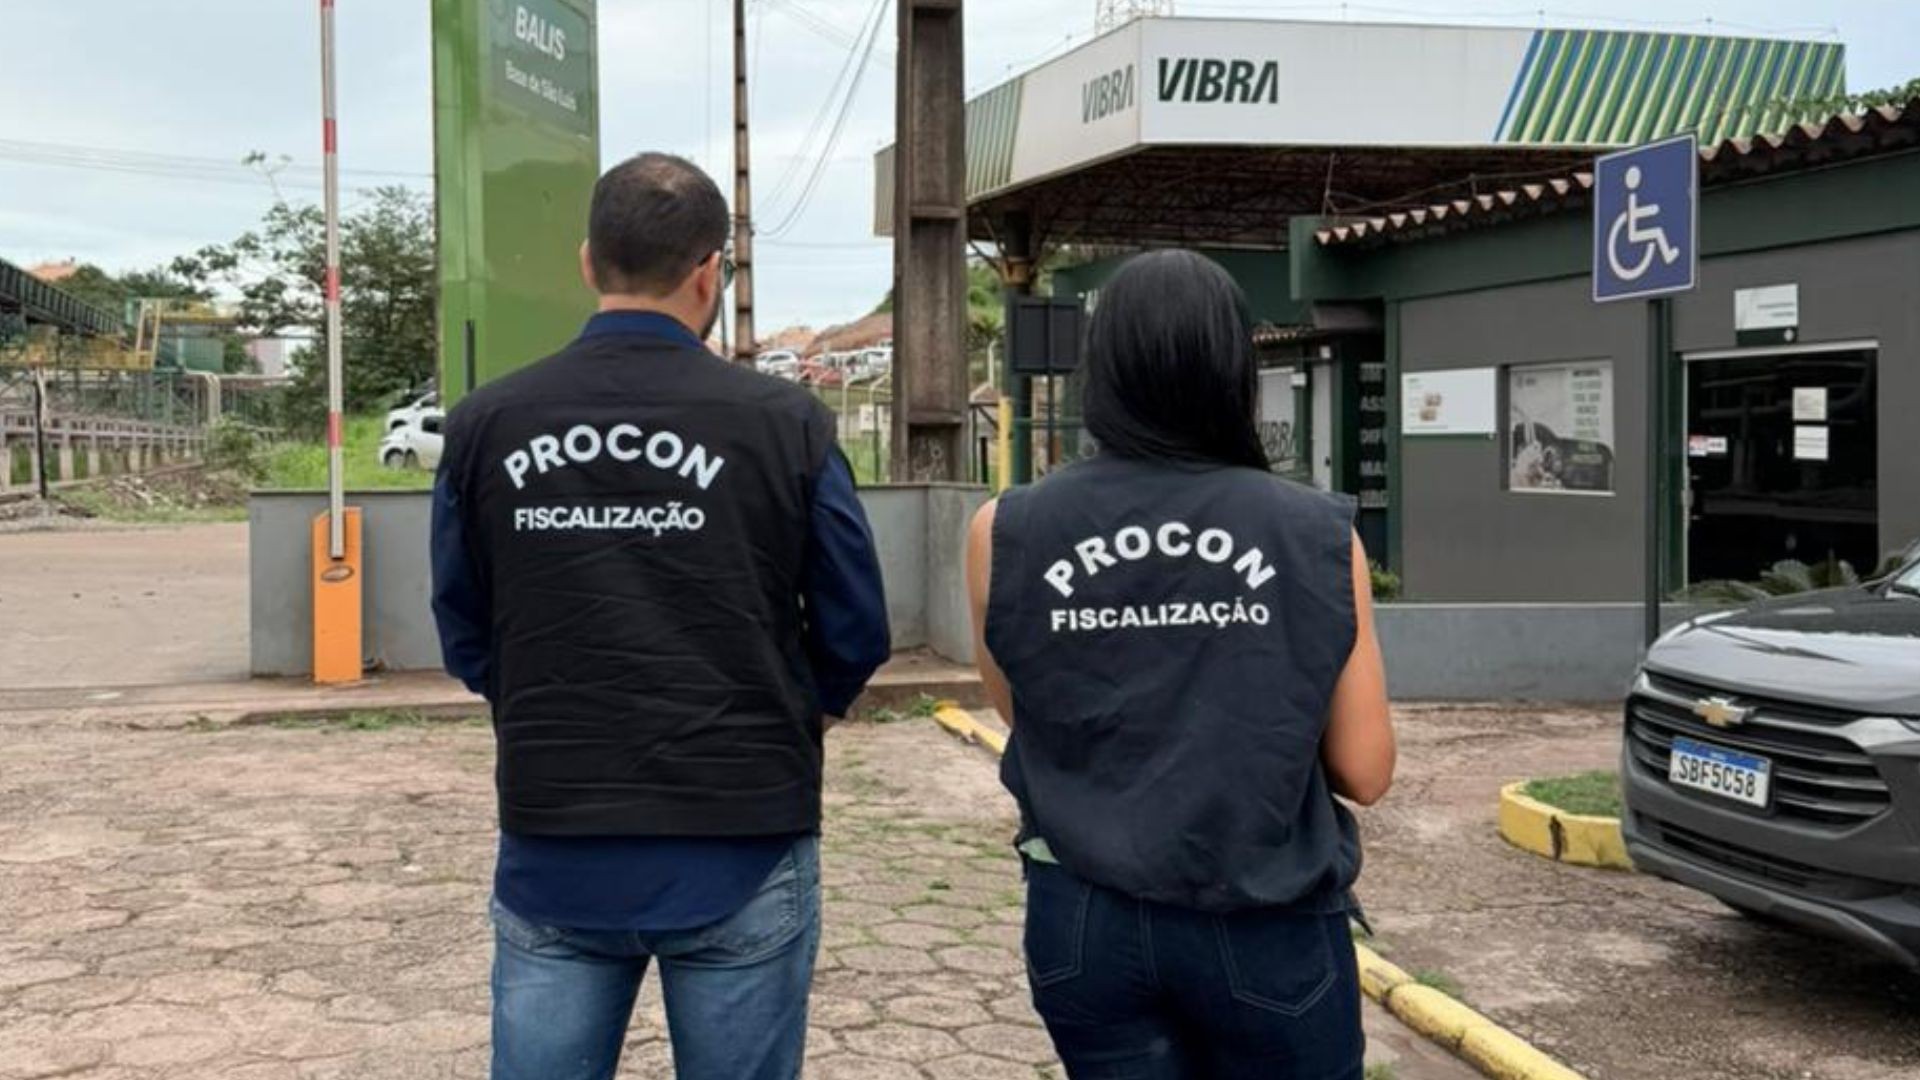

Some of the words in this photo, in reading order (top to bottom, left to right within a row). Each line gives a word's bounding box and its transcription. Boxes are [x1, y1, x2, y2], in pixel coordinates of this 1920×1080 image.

[515, 5, 566, 61] BALIS
[1081, 63, 1134, 124] VIBRA
[1157, 57, 1279, 104] VIBRA
[503, 423, 725, 490] PROCON
[514, 501, 705, 537] FISCALIZAÇÃO
[1043, 521, 1277, 598] PROCON
[1678, 755, 1756, 798] SBF5C58
